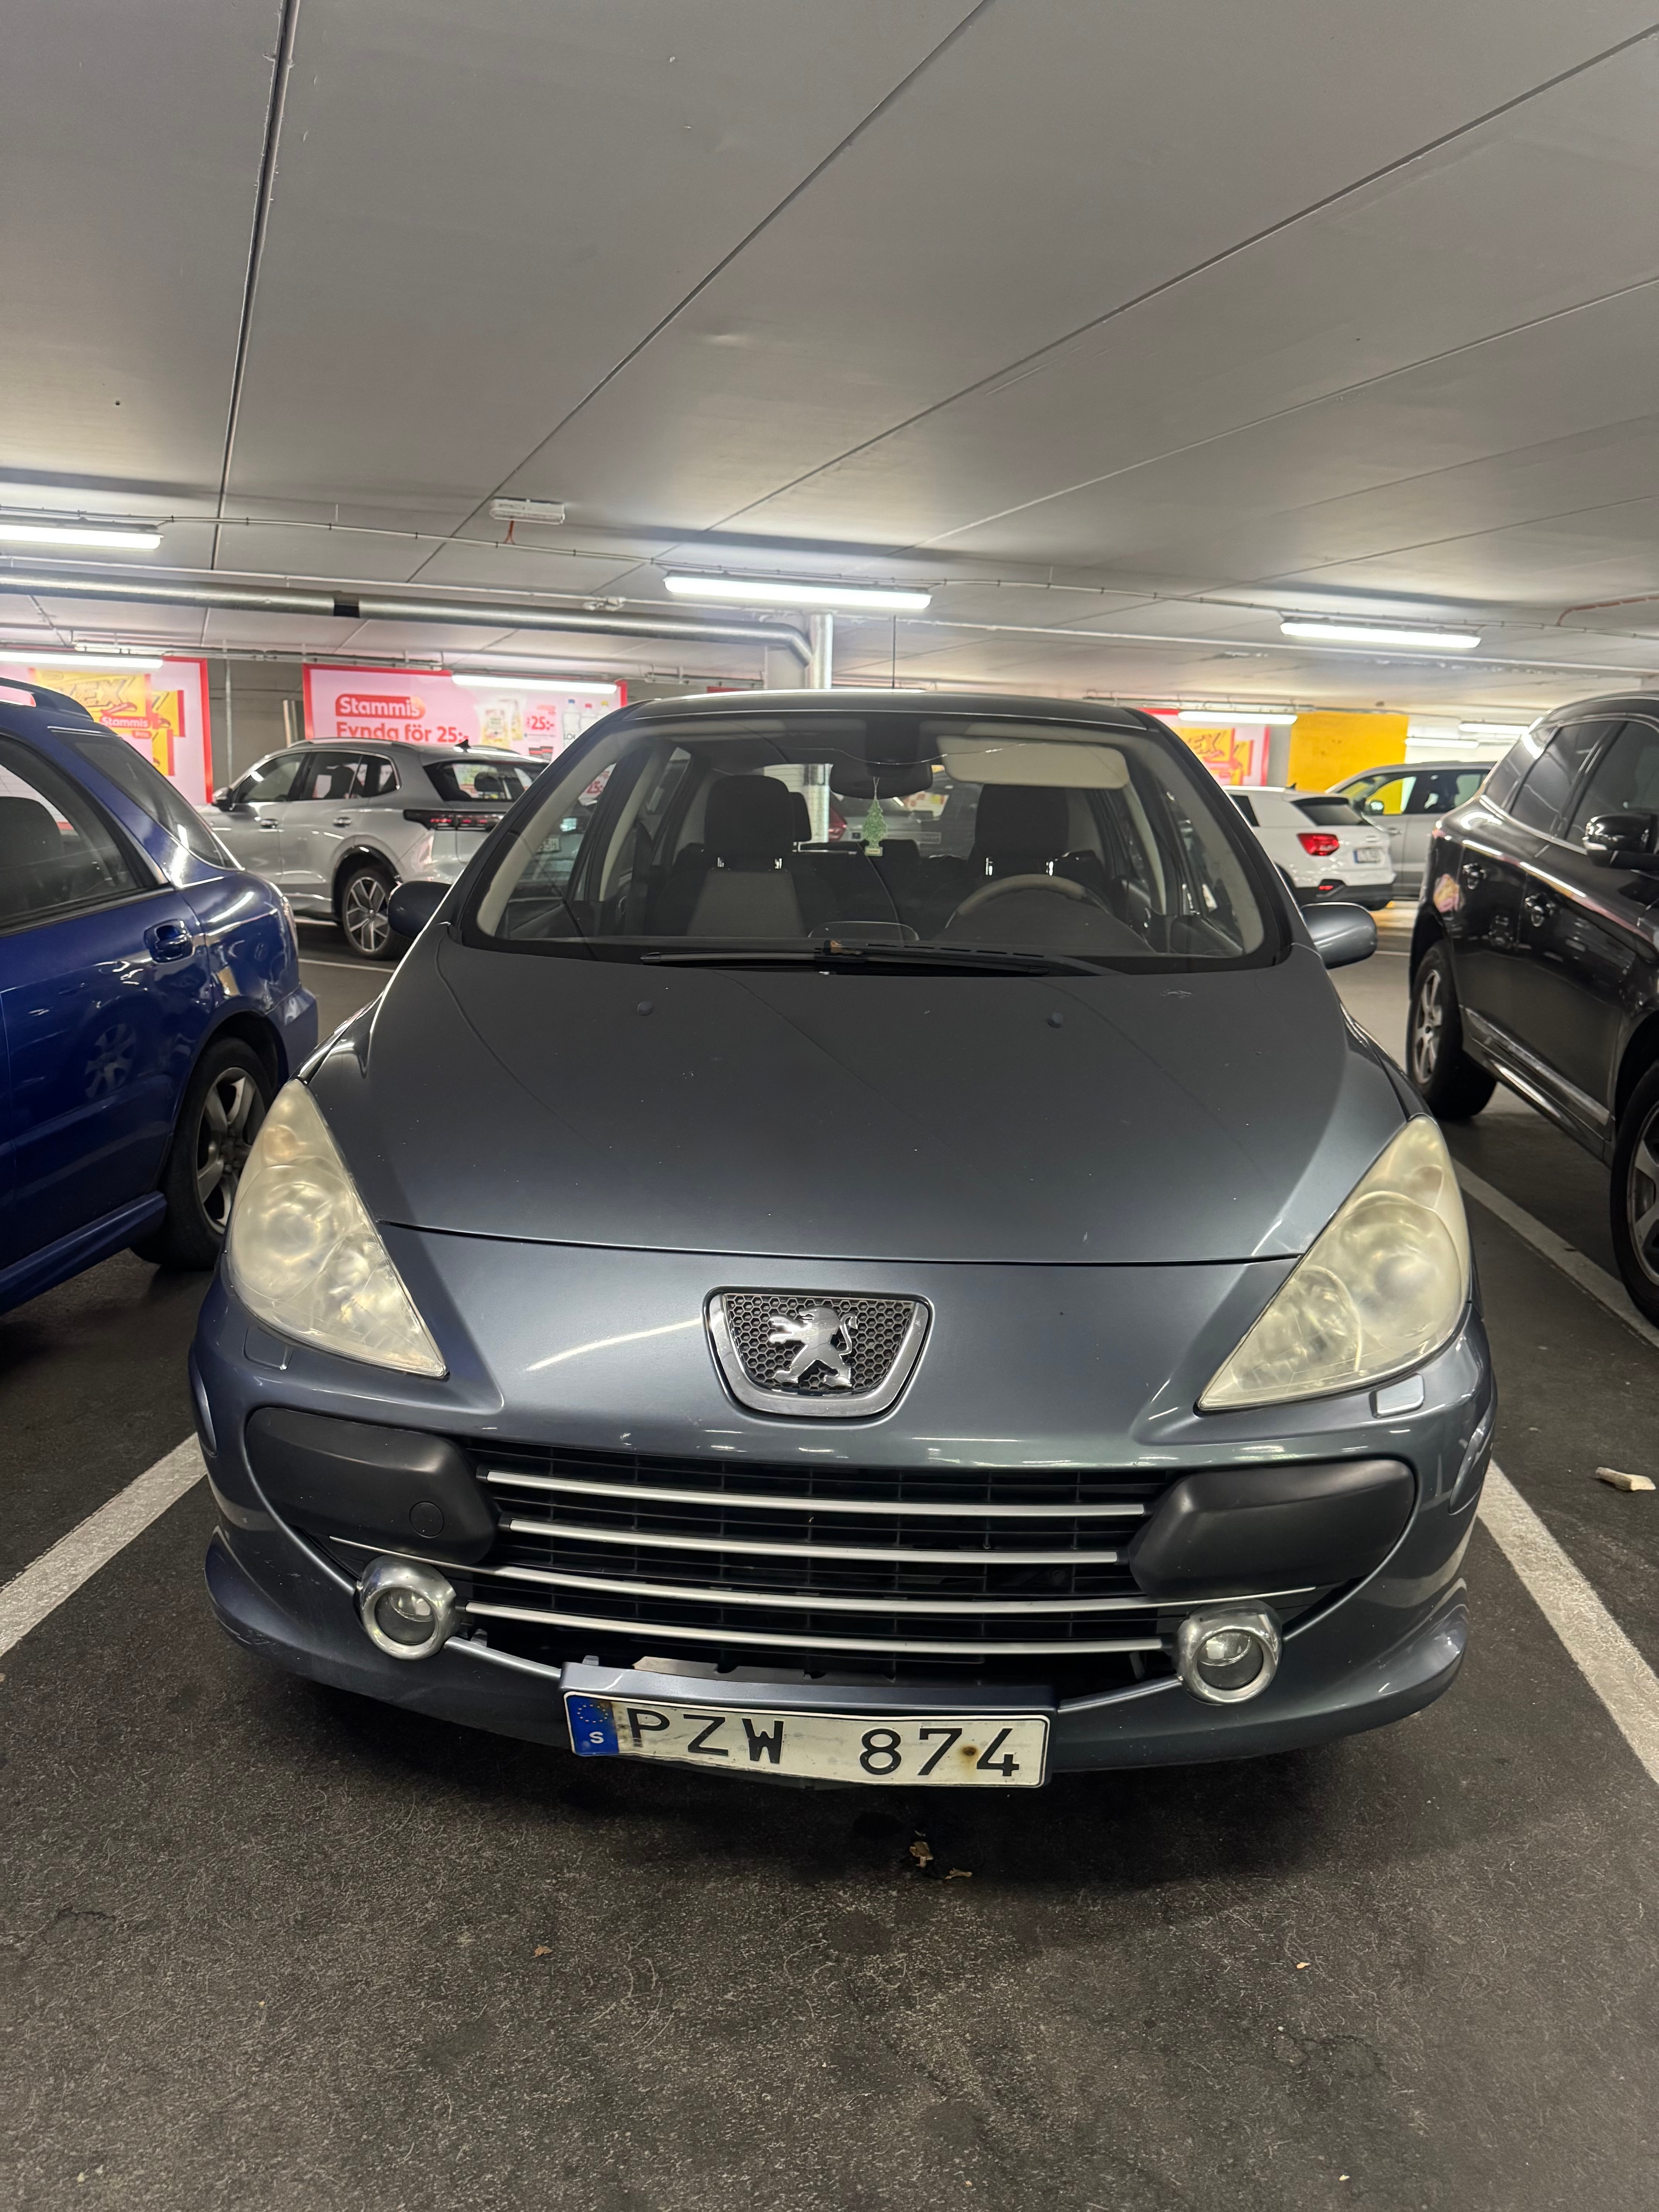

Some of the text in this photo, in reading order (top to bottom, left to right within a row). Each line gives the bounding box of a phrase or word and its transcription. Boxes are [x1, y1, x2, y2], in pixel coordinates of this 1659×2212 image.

[340, 697, 420, 716] Stammis
[101, 716, 149, 728] Stammis
[531, 716, 555, 731] 25:-
[337, 721, 399, 740] Fynda
[404, 724, 432, 741] för
[589, 1731, 604, 1744] S
[626, 1707, 1020, 1776] PZW 874
